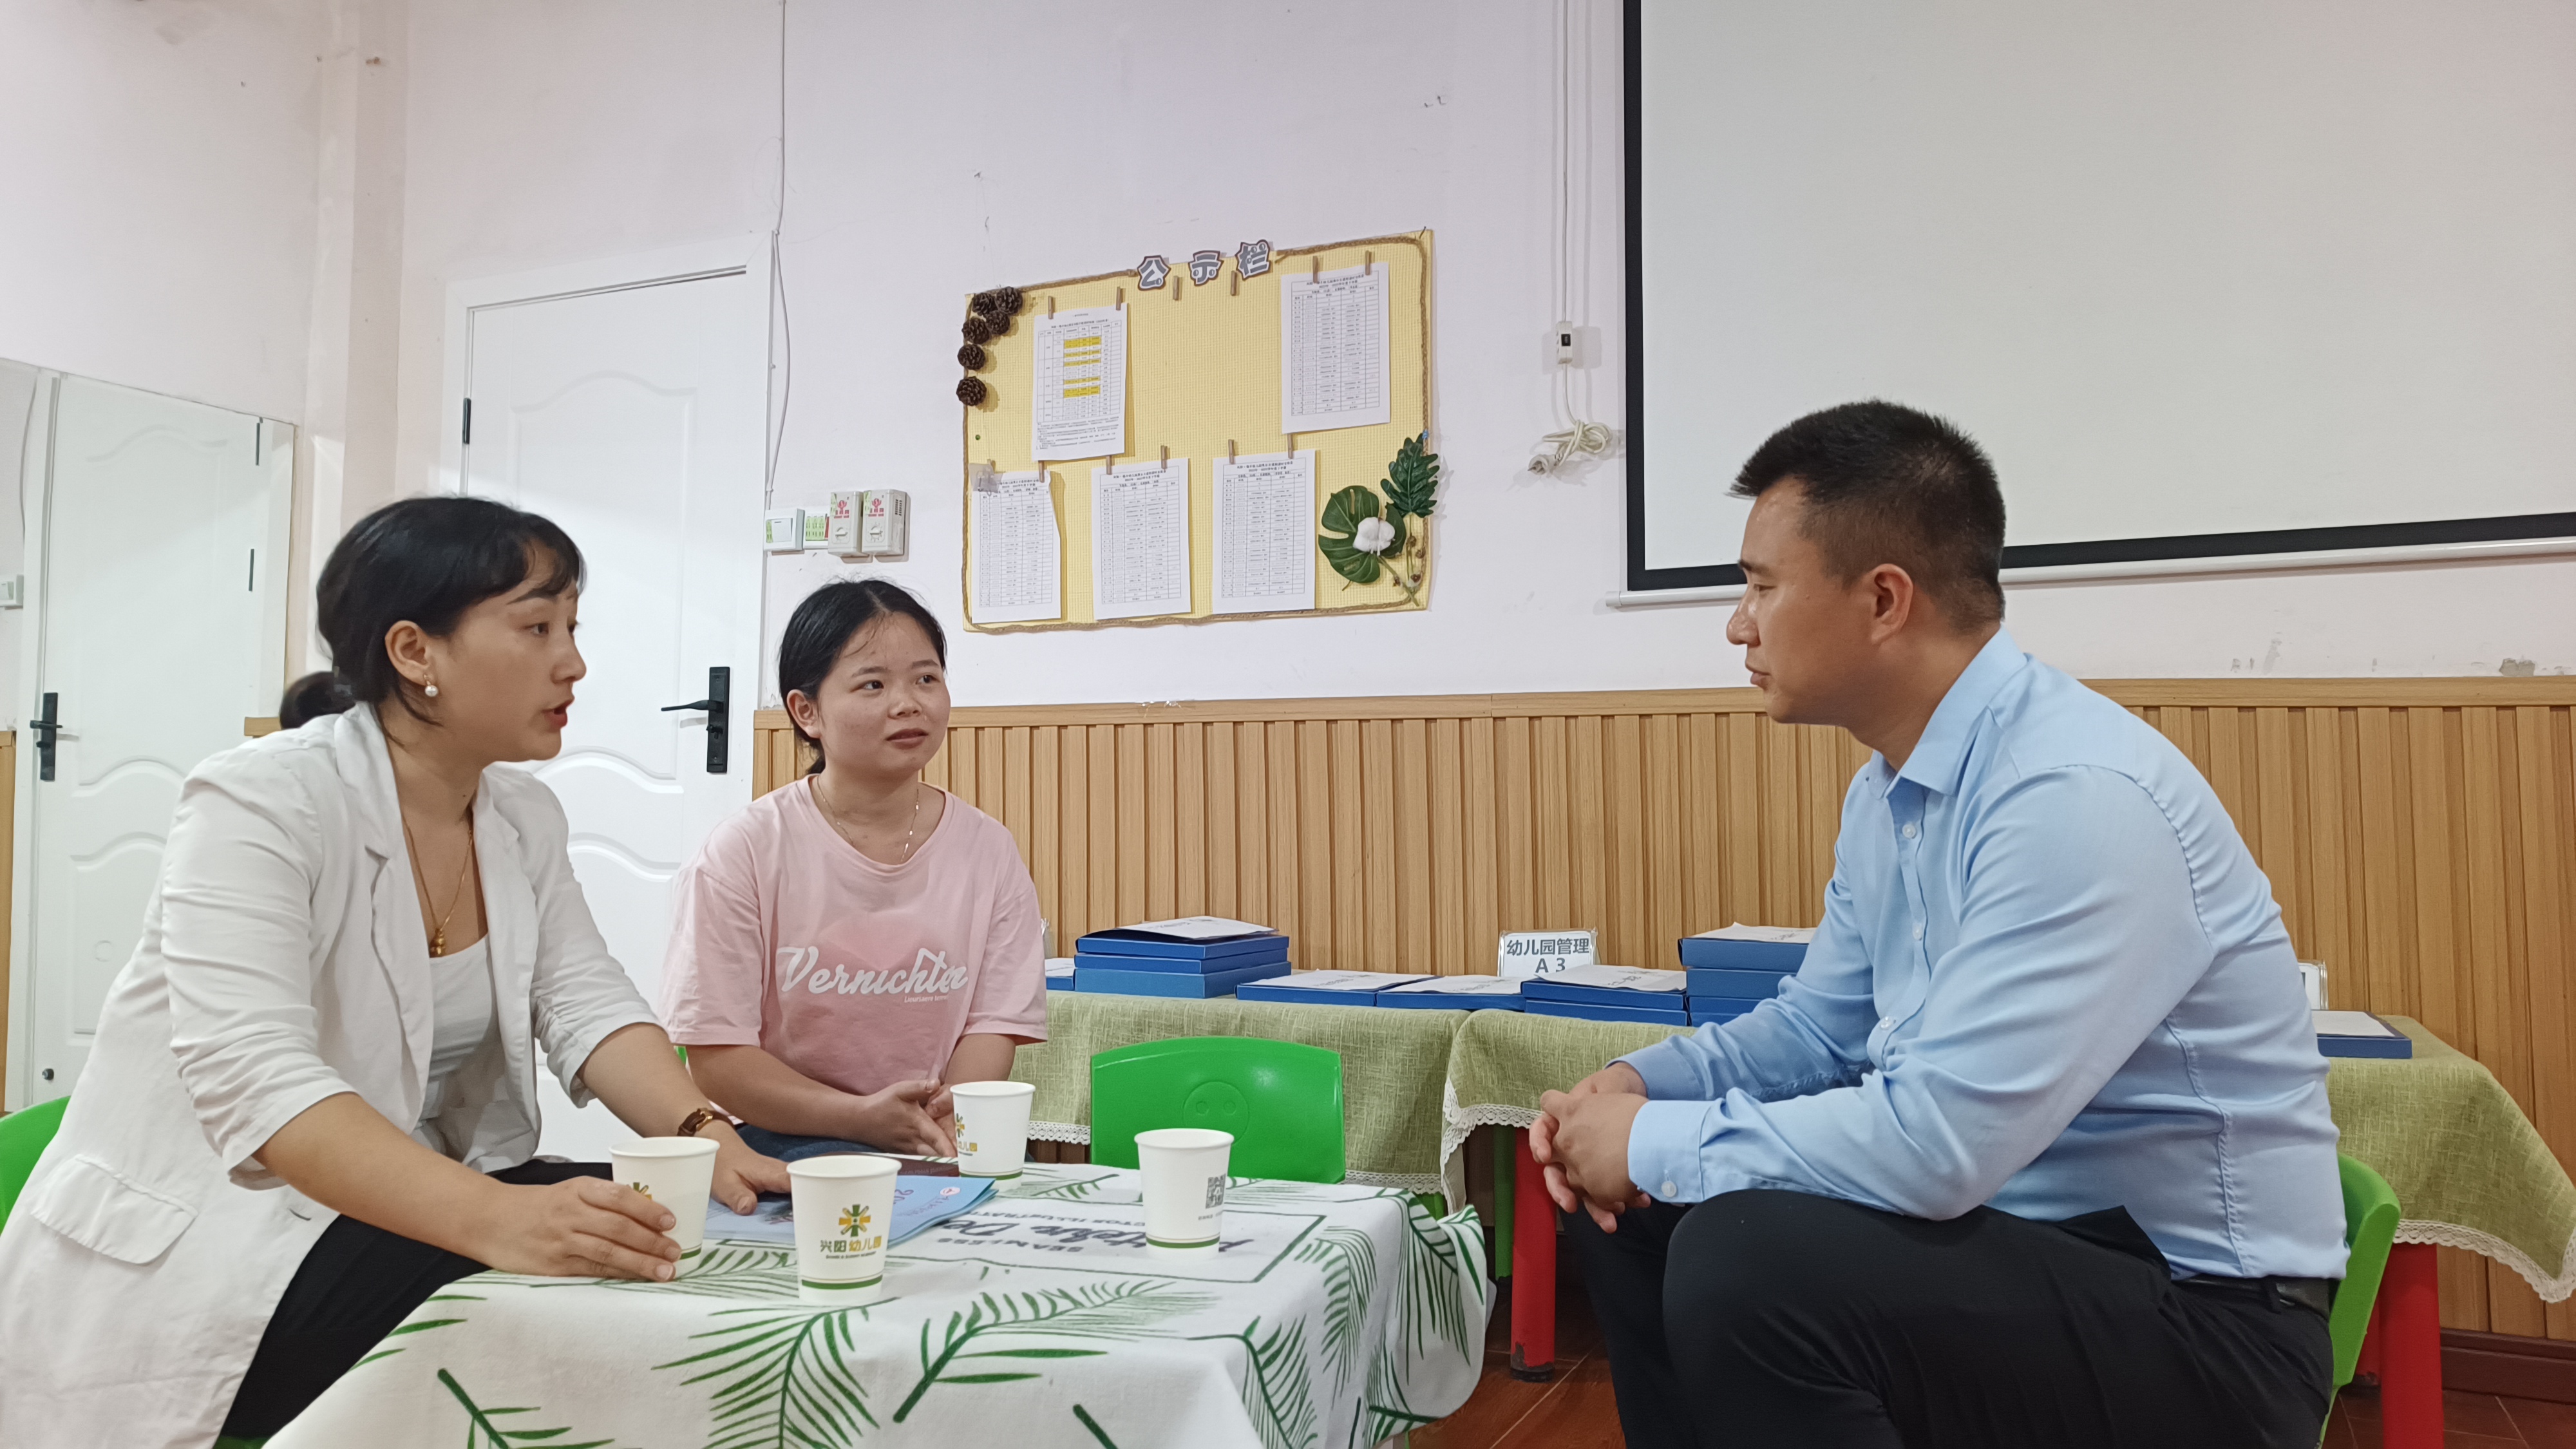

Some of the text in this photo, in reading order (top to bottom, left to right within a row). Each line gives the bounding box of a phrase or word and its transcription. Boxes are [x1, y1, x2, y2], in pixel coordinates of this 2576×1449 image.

[1139, 243, 1267, 287] 公示栏
[1506, 938, 1590, 956] 幼儿园管理
[1535, 957, 1566, 974] A 3
